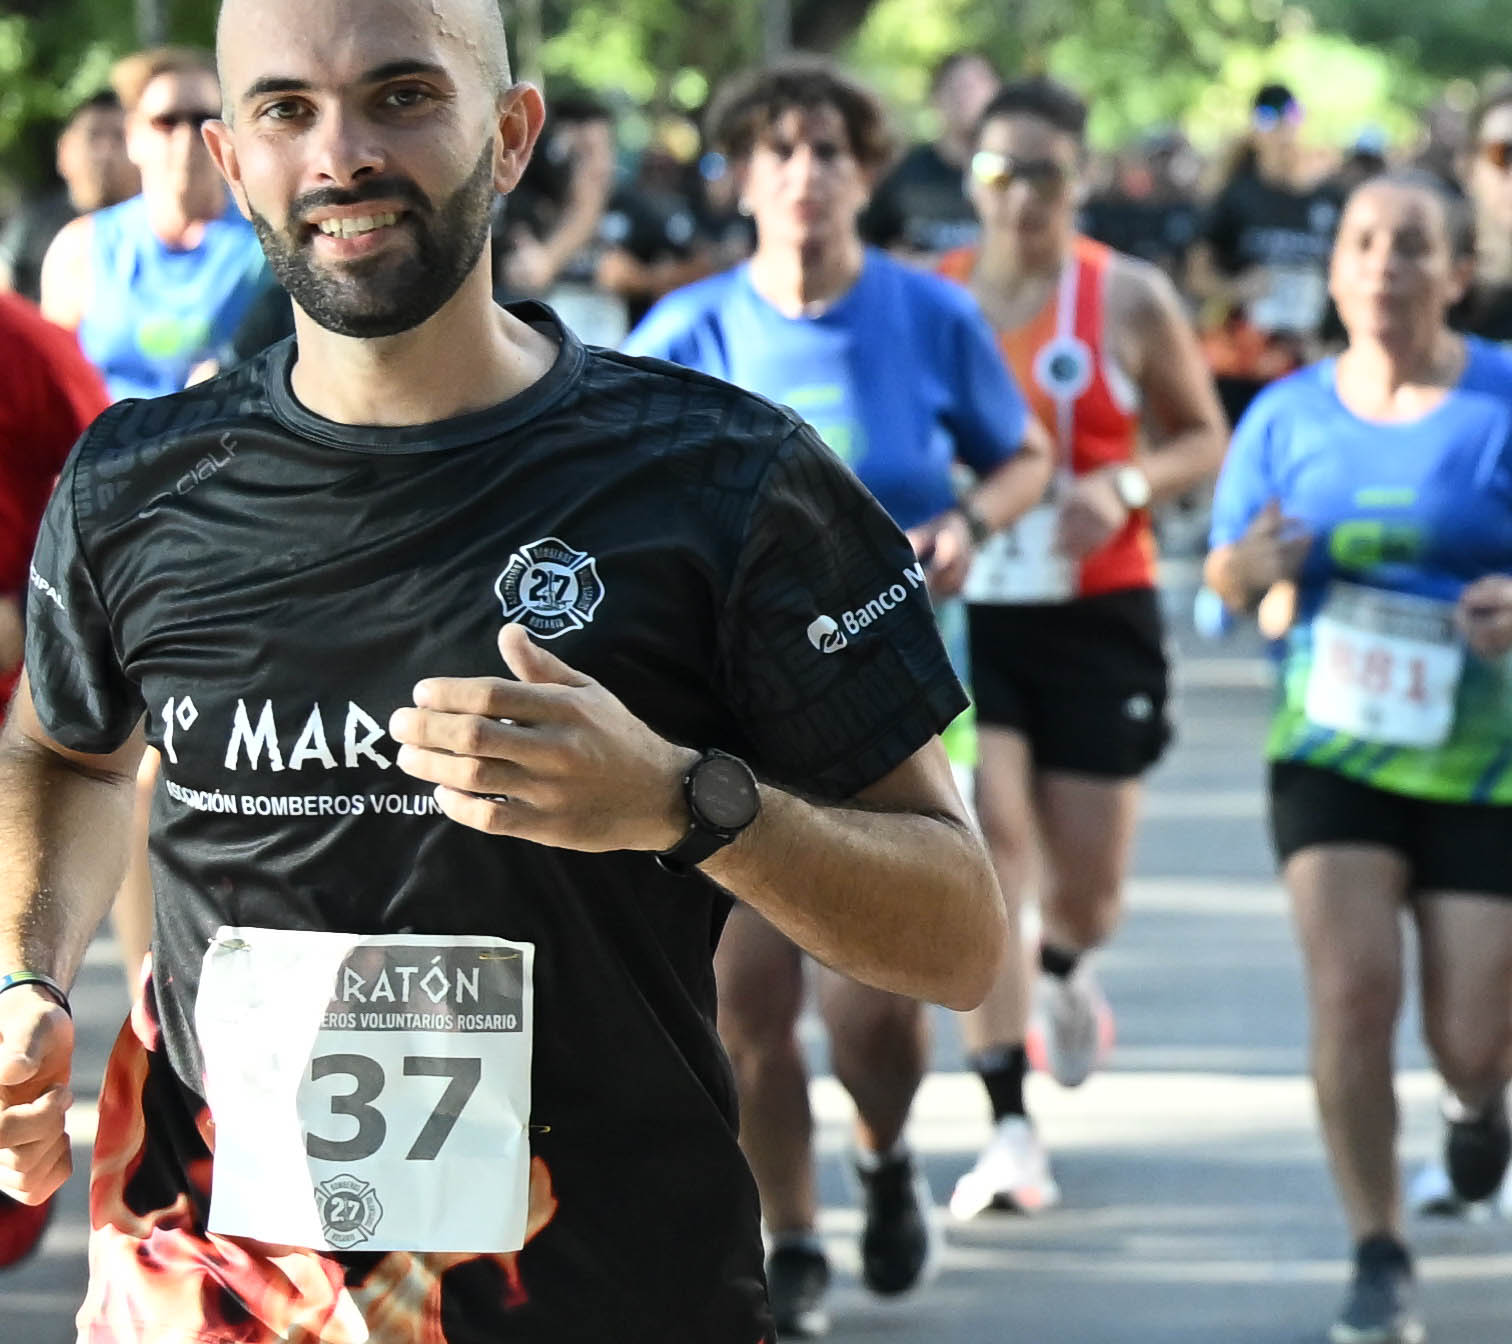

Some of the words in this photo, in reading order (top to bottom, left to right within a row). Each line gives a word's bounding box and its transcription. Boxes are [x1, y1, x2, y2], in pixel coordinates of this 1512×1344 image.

[529, 568, 571, 601] 27
[841, 584, 908, 635] Banco
[224, 697, 393, 772] MAR
[242, 794, 365, 816] BOMBEROS
[369, 794, 443, 816] VOLUN
[332, 954, 481, 1004] RATÓN
[321, 1011, 357, 1029] EROS
[359, 1012, 454, 1031] VOLUNTARIOS
[456, 1013, 517, 1031] ROSARIO
[331, 1197, 361, 1223] 27
